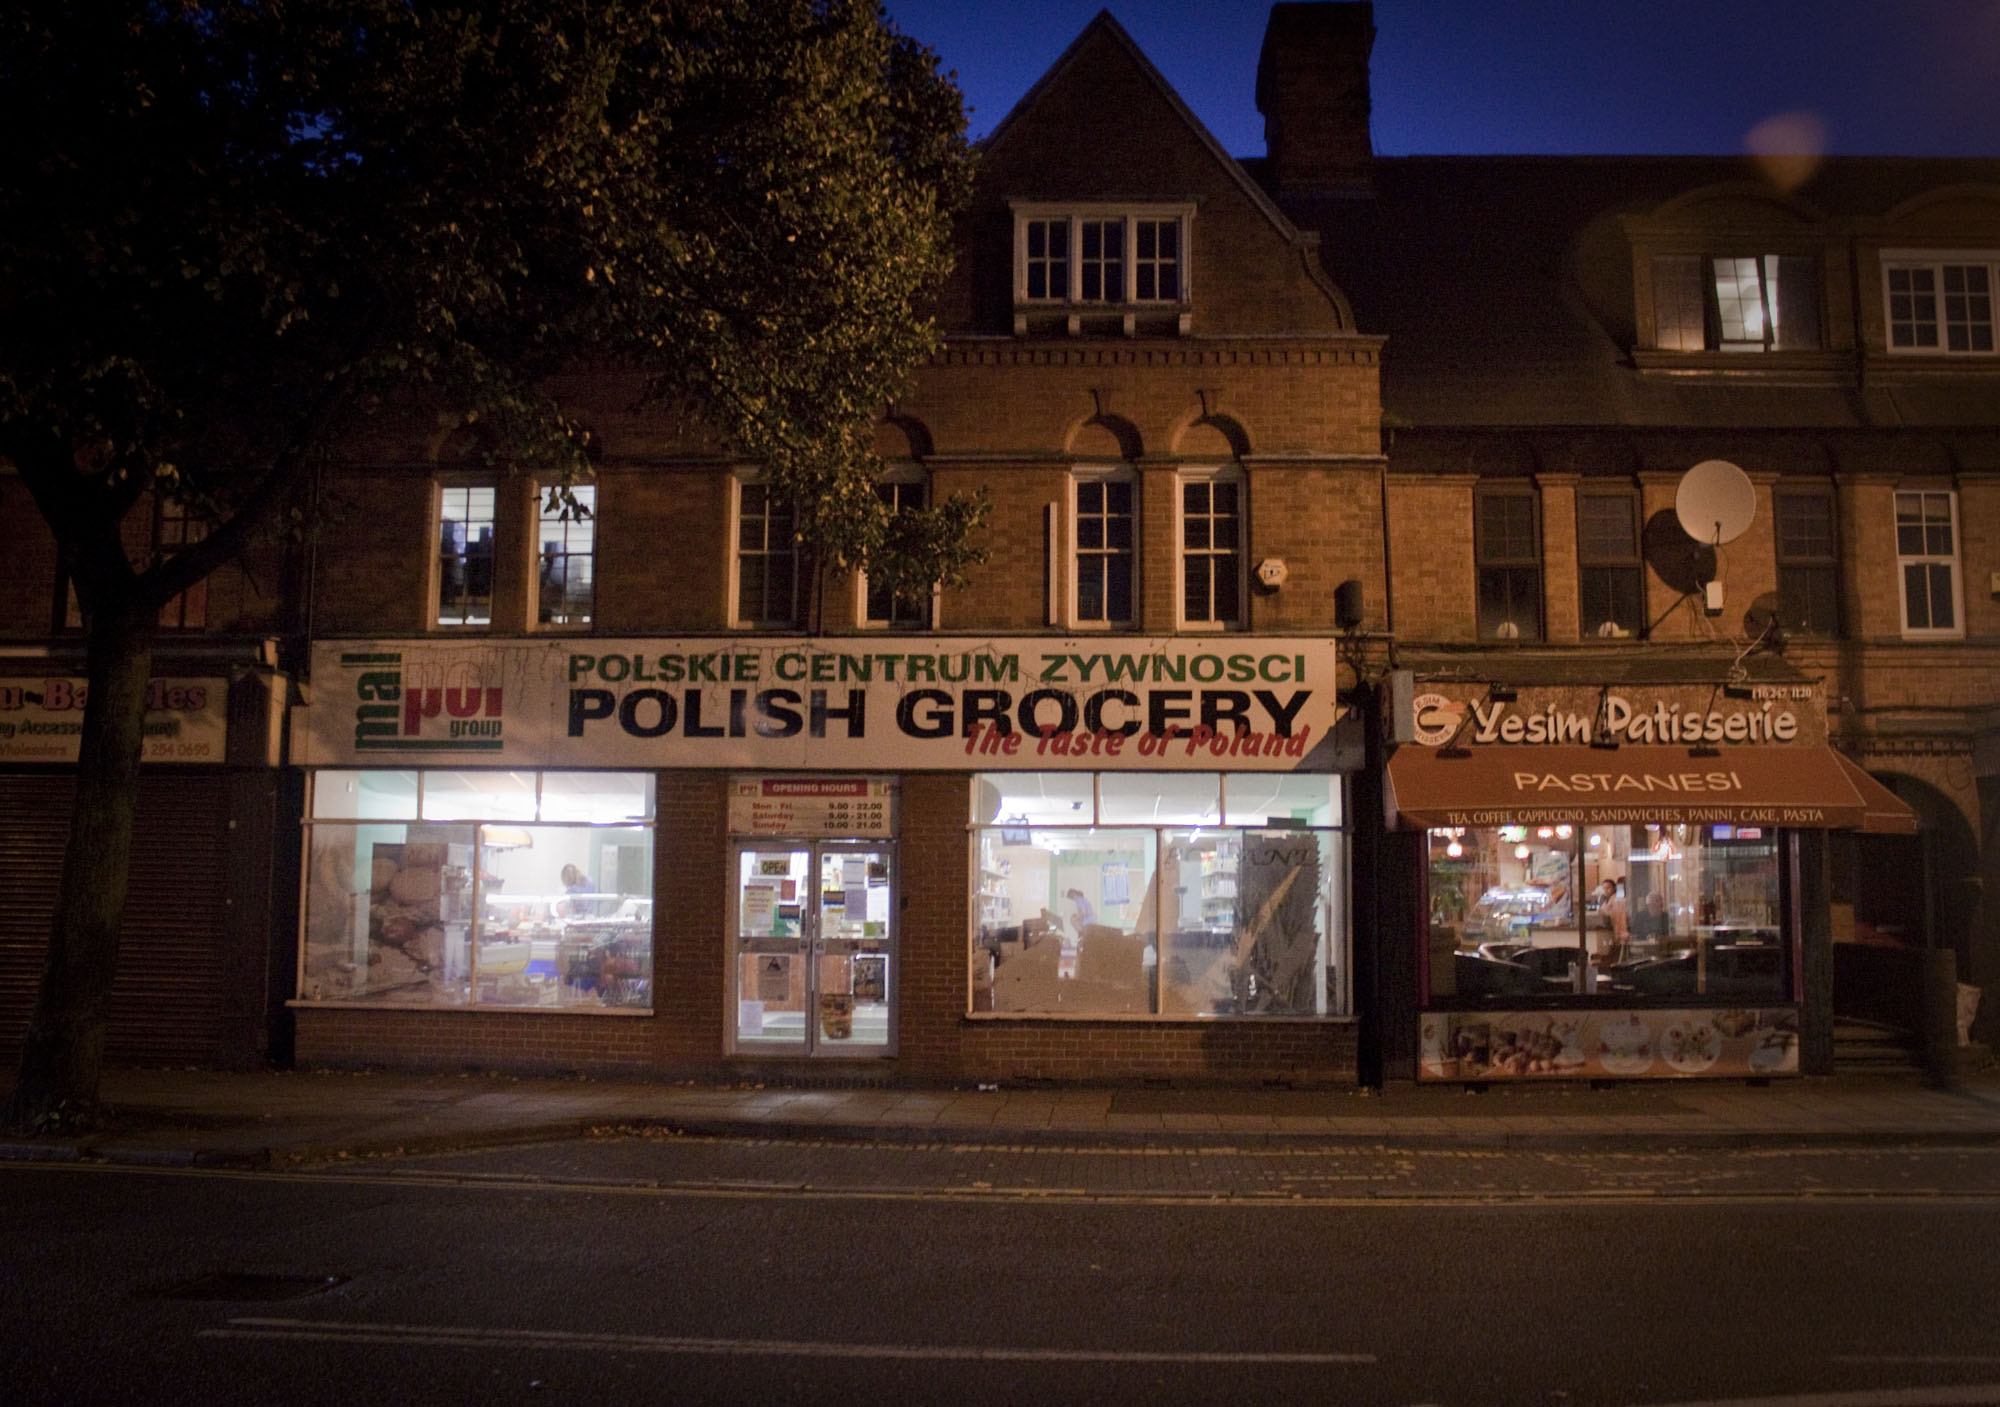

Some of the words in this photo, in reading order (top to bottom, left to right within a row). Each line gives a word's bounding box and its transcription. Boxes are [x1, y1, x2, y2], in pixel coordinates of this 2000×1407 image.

[567, 653, 759, 682] POLSKIE
[775, 653, 1019, 683] CENTRUM
[1040, 653, 1306, 683] ZYWNOSCI
[404, 661, 503, 736] pol
[567, 688, 865, 739] POLISH
[895, 688, 1314, 740] GROCERY
[1470, 698, 1592, 744] Yesim
[1606, 695, 1799, 743] Patisserie
[450, 718, 503, 739] group
[963, 722, 1023, 757] The
[1034, 723, 1125, 757] Taste
[1137, 723, 1182, 757] of
[1186, 723, 1312, 758] Poland
[150, 742, 176, 756] 254
[772, 783, 818, 793] OPENING
[820, 783, 858, 793] HOURS
[1513, 771, 1743, 792] PASTANESI
[752, 802, 772, 811] Mon
[779, 802, 793, 811] Fri
[856, 802, 883, 811] 22.00
[752, 811, 795, 822] Saturday
[856, 812, 883, 820] 21.00
[1783, 807, 1824, 821] PASTA
[752, 820, 787, 830] Sunday
[856, 821, 883, 830] 21.00
[761, 861, 788, 874] OPEN
